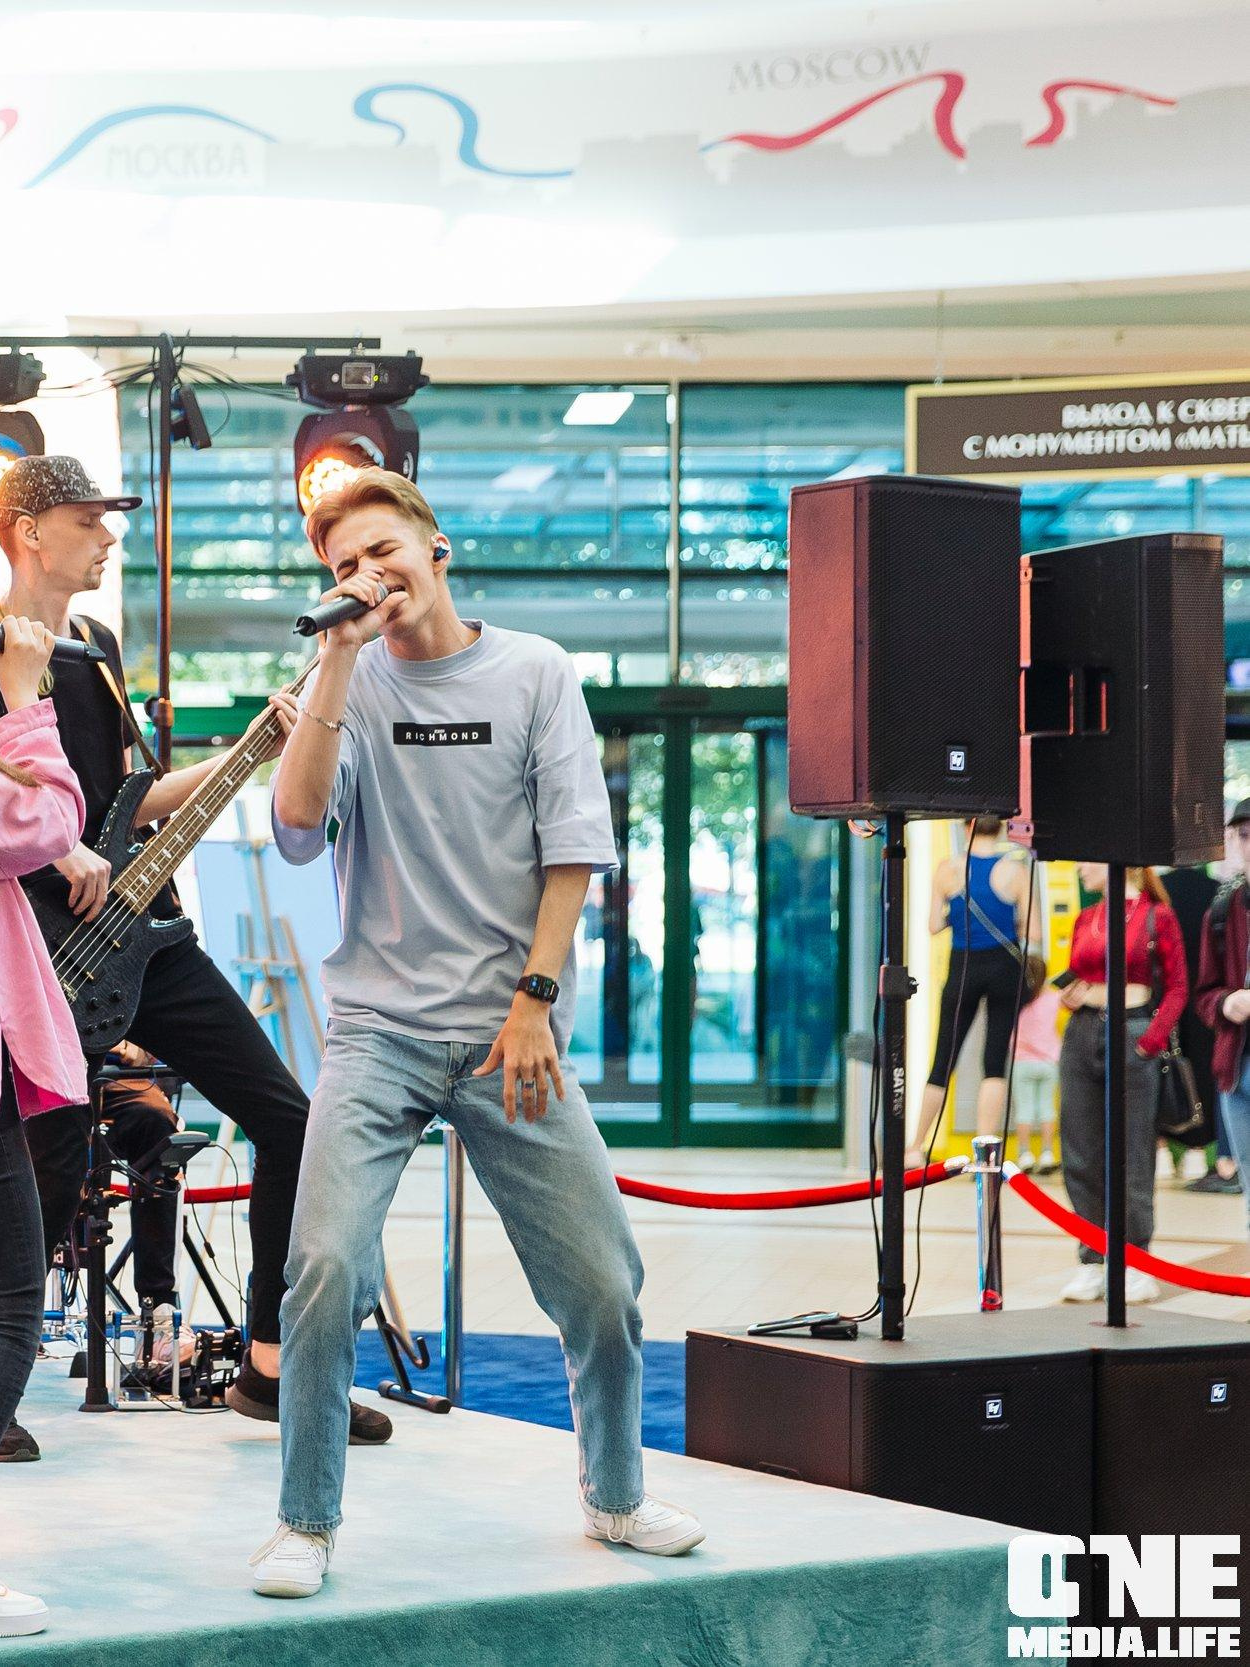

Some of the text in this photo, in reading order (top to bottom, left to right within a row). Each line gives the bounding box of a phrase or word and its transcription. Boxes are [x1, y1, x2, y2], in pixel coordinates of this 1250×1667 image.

[728, 41, 932, 95] MOSCOW
[106, 140, 250, 181] МОСКВА
[1062, 401, 1154, 429] ВЫХОД
[1156, 400, 1176, 424] К
[962, 434, 984, 460] С
[984, 427, 1171, 459] МОНУМЕНТОМ
[405, 731, 479, 741] RICHMOND
